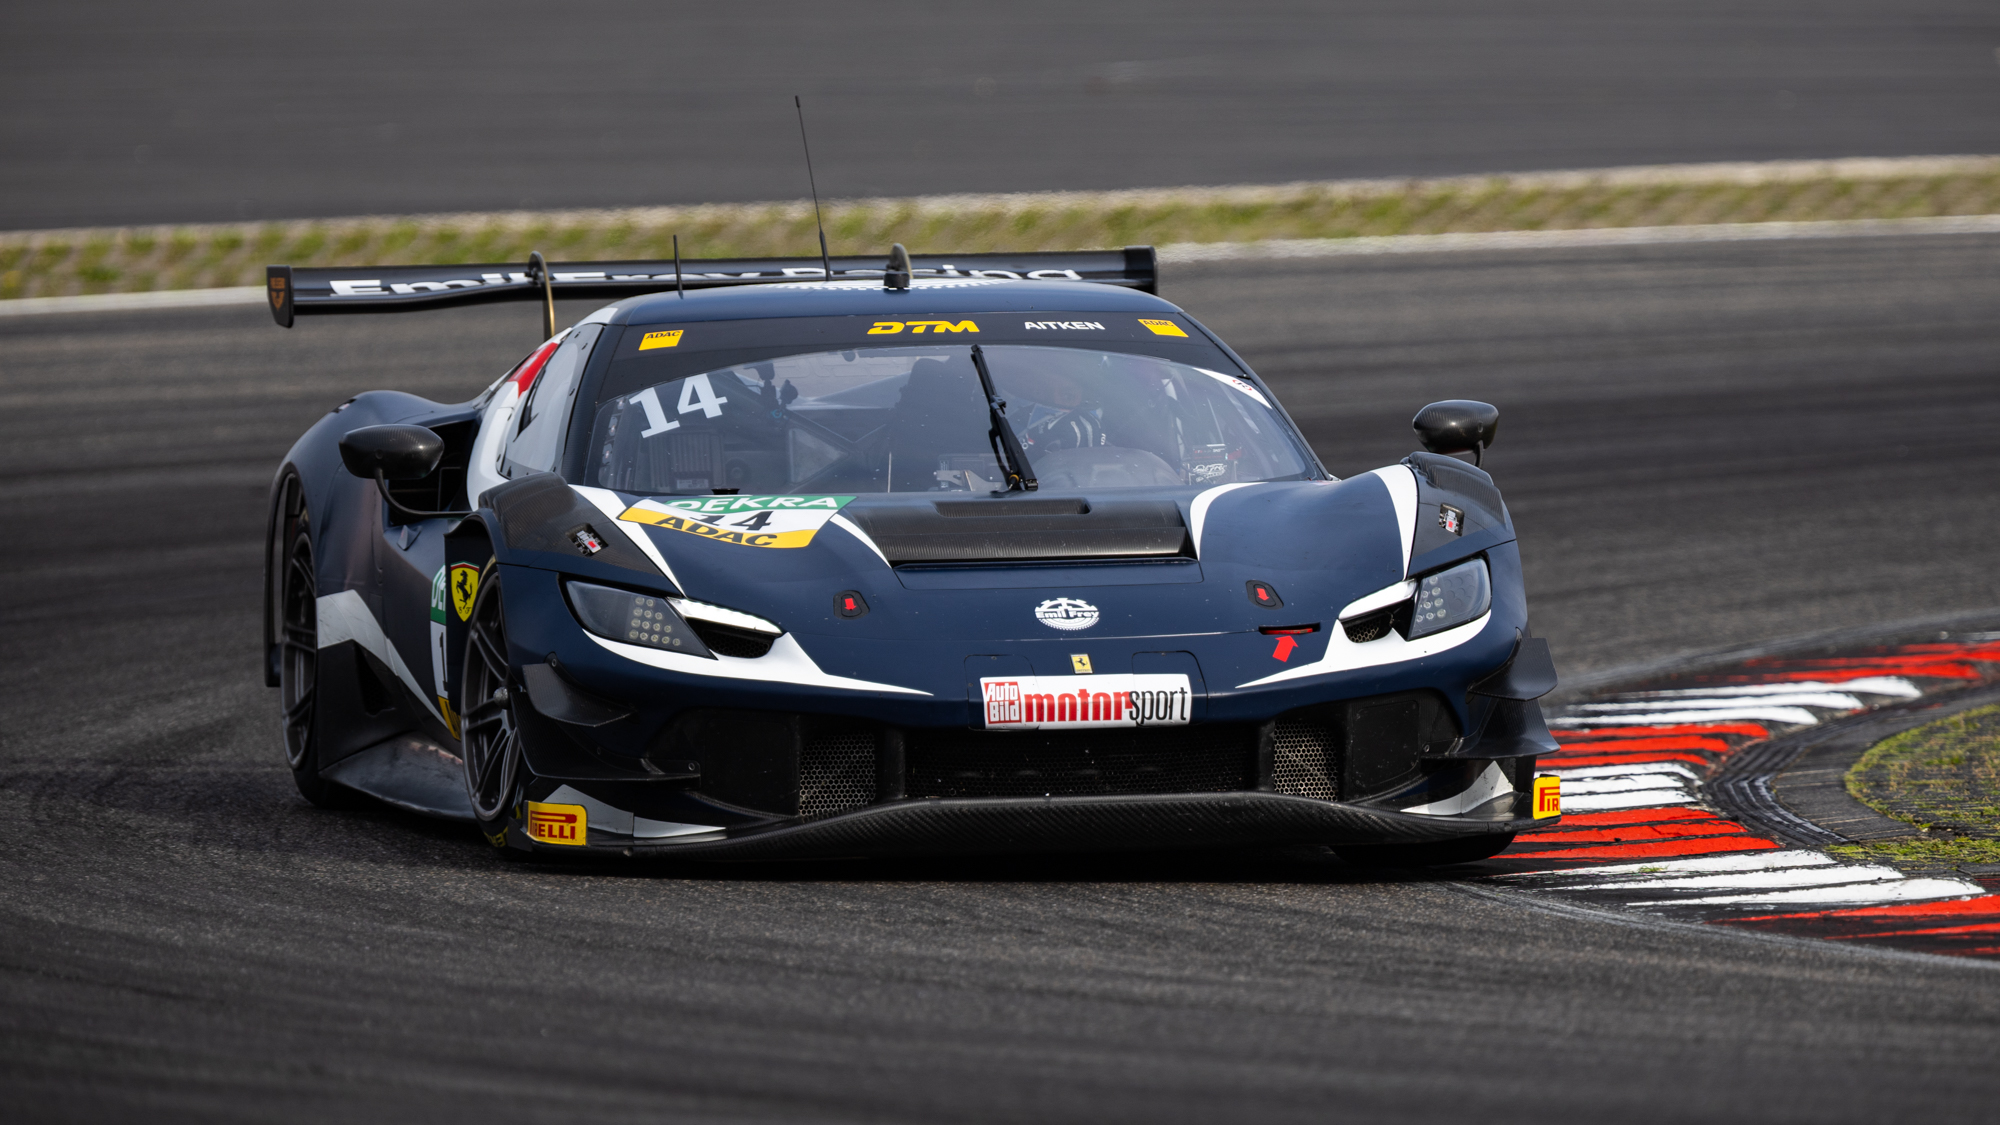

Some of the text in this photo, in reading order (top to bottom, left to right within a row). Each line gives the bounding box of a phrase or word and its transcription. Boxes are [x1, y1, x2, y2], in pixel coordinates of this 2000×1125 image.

[329, 272, 528, 297] Emil
[781, 264, 1083, 281] Ring
[867, 320, 980, 335] DTM
[1024, 320, 1105, 331] AITKEN
[645, 331, 681, 340] ADAC
[628, 373, 728, 439] 14
[667, 496, 838, 512] DEKRA
[689, 511, 774, 531] 14
[653, 516, 778, 547] ADAC
[1035, 609, 1100, 619] Emil Frey
[985, 682, 1019, 701] Auto
[988, 700, 1021, 722] Bild
